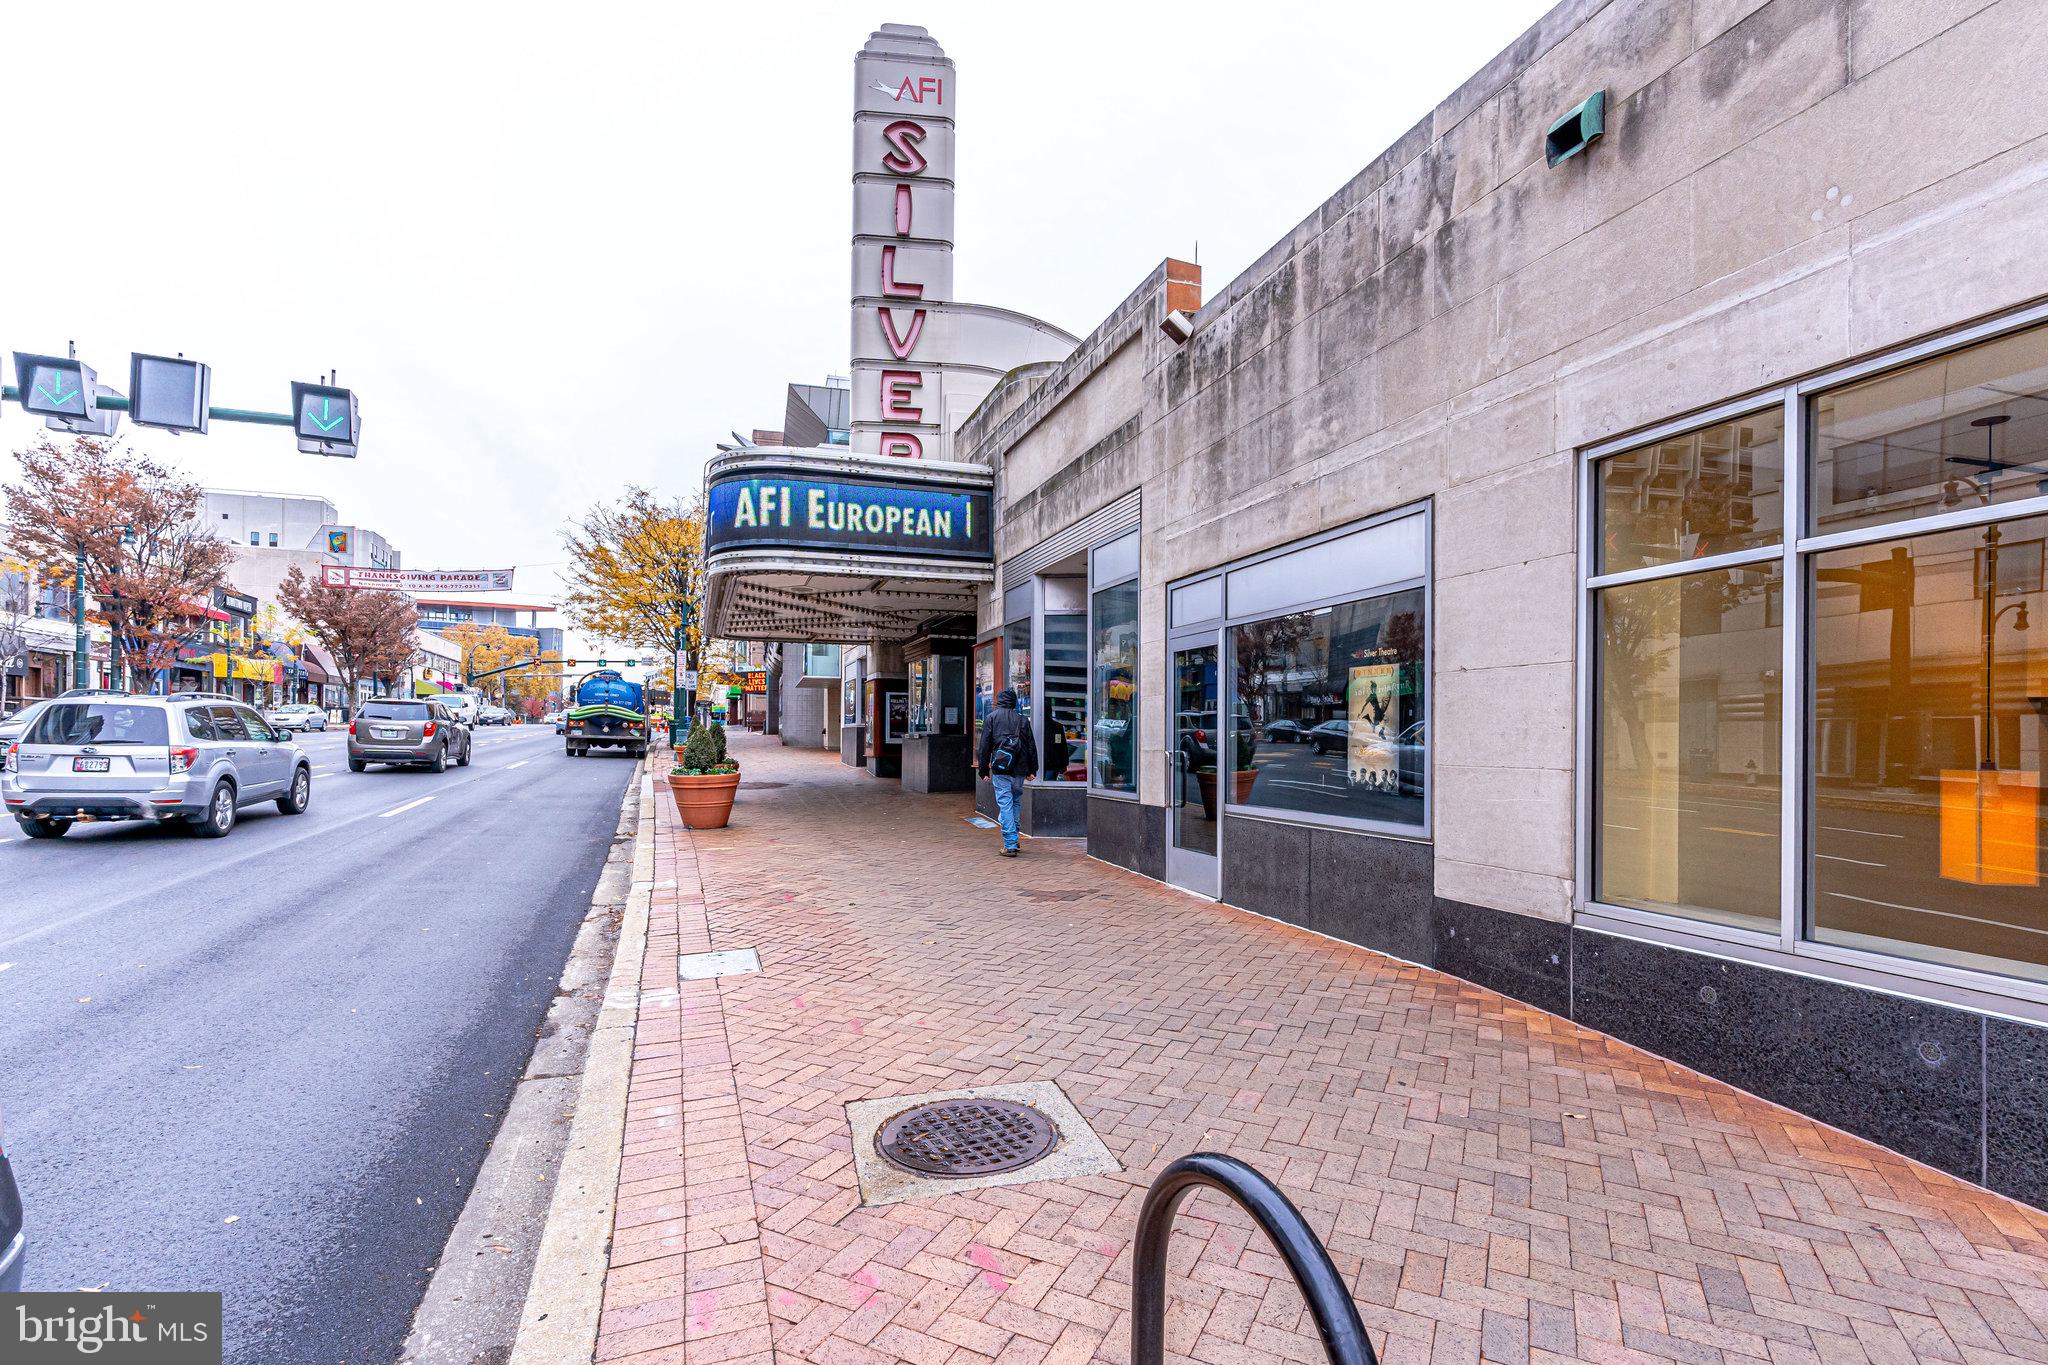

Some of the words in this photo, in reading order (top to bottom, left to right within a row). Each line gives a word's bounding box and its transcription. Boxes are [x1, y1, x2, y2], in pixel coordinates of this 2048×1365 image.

[896, 76, 942, 105] AFI
[734, 487, 791, 528] AFI
[808, 489, 951, 539] EUROPEAN
[357, 571, 436, 581] THANKSGIVING
[440, 573, 481, 581] PARADE
[1364, 649, 1377, 658] Silver
[1378, 647, 1398, 656] Theatre
